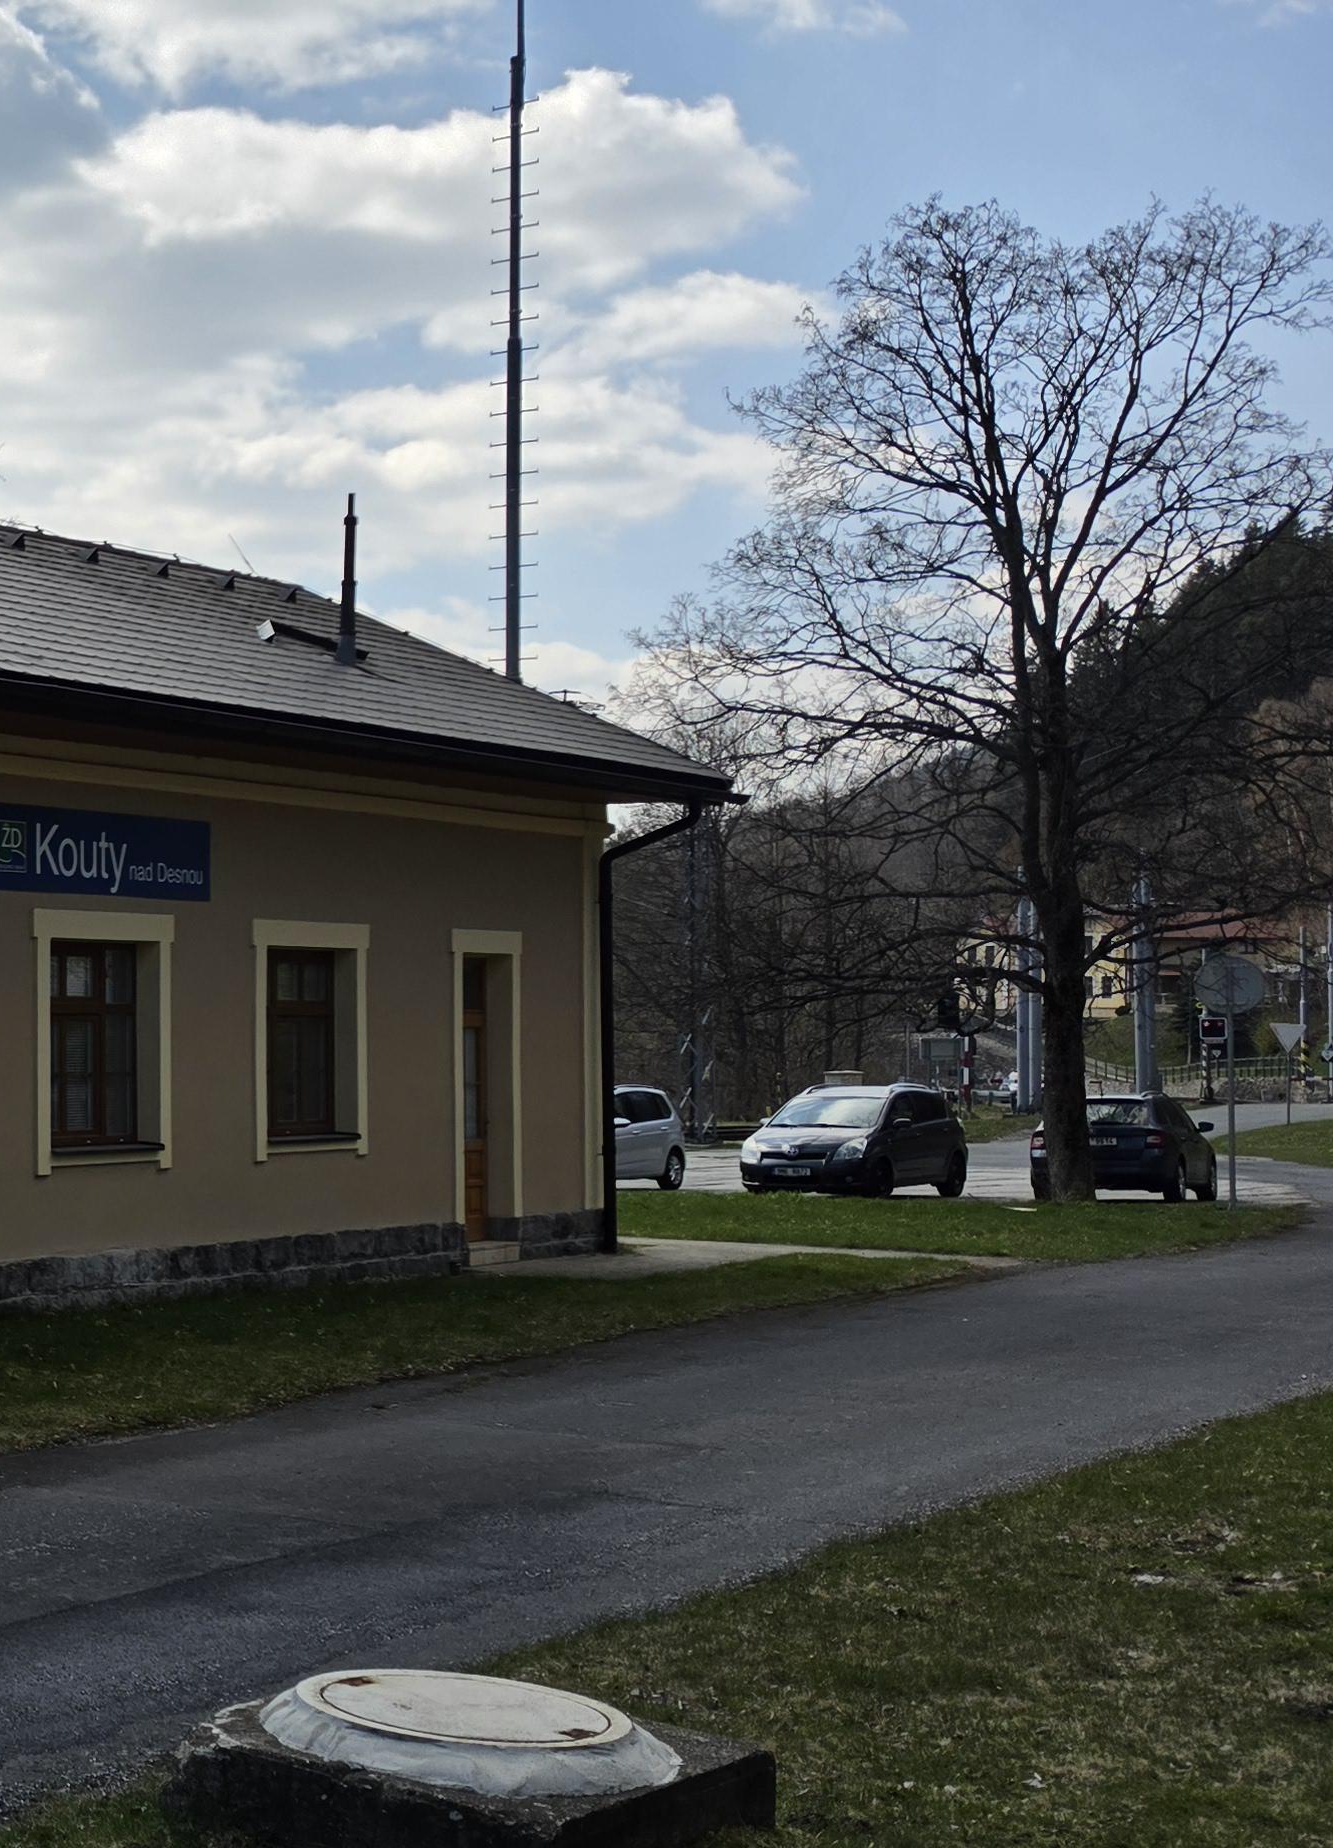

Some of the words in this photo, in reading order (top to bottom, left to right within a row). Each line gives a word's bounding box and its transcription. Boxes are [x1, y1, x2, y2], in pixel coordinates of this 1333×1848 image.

[35, 822, 128, 894] Kouty
[129, 862, 153, 882] nad
[157, 862, 204, 885] Desnou
